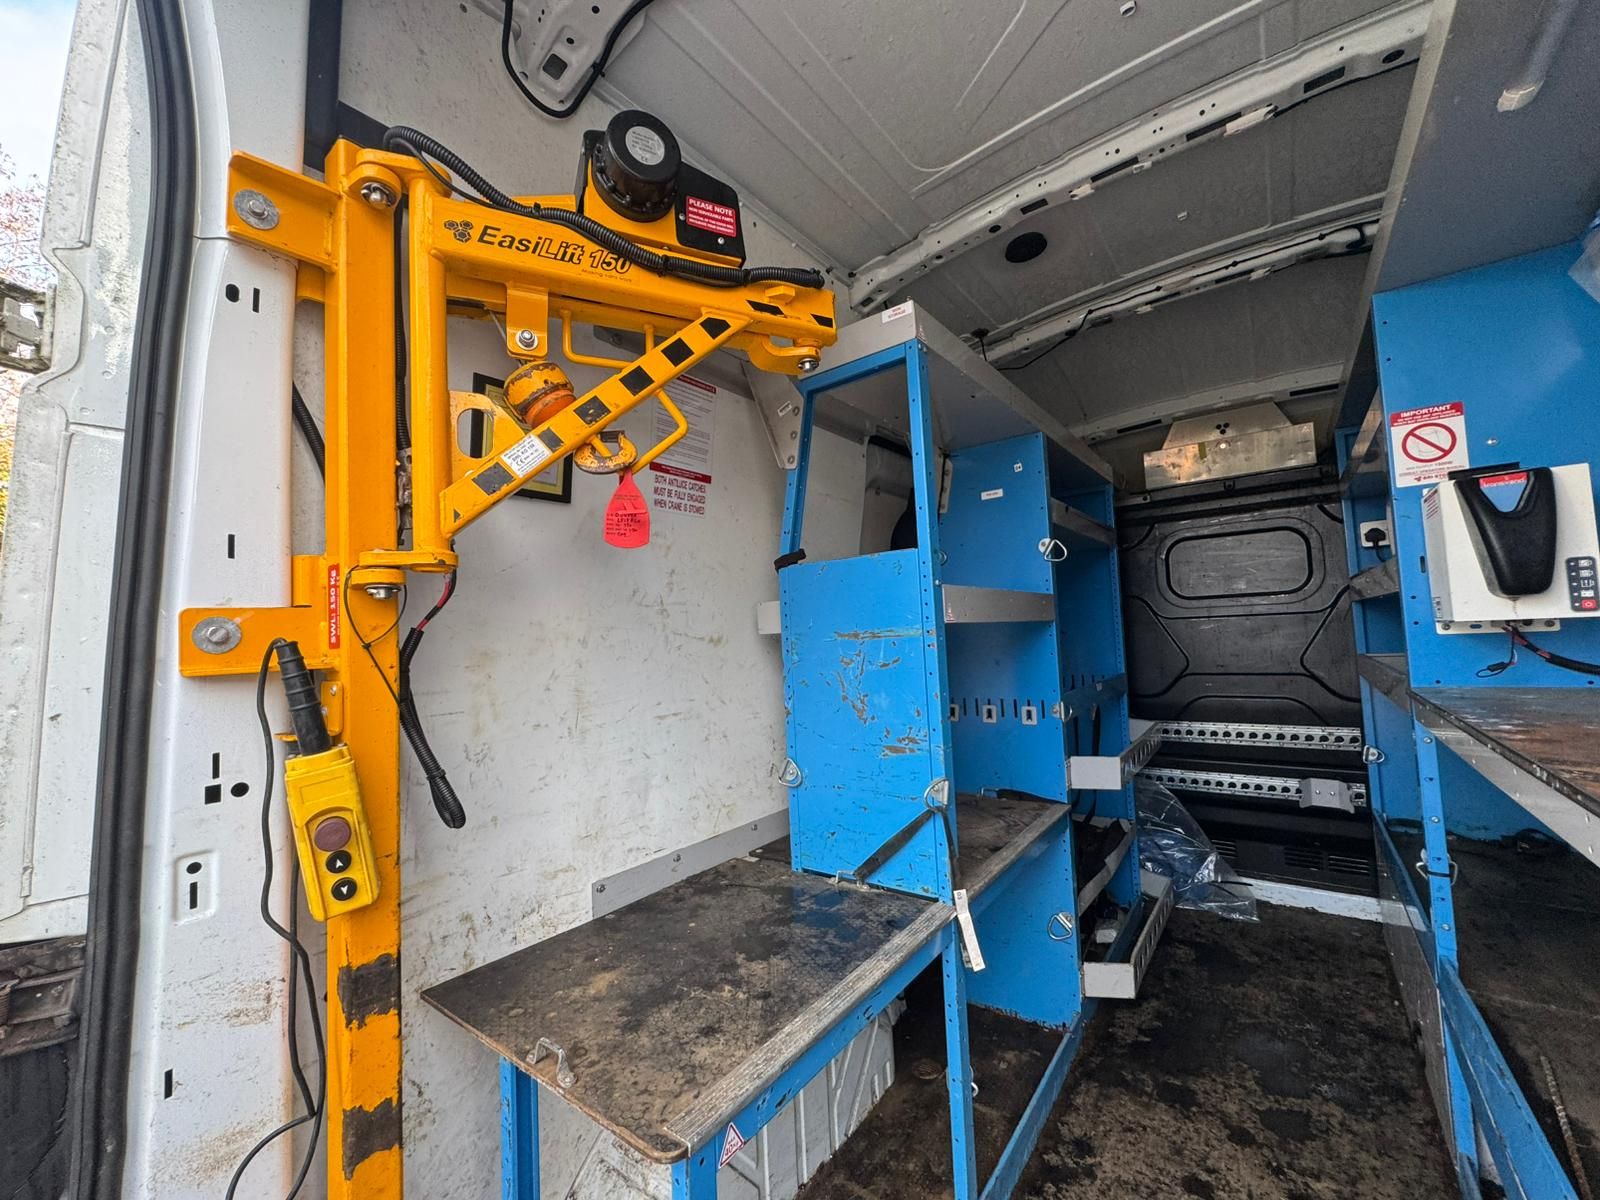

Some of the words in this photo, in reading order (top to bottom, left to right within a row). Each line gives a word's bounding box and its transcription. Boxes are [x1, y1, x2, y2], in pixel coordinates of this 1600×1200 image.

[688, 198, 713, 211] PLEASE
[714, 205, 733, 217] NOTE
[477, 225, 585, 265] EasiLift
[589, 248, 632, 274] 150
[1400, 404, 1452, 418] IMPORTANT
